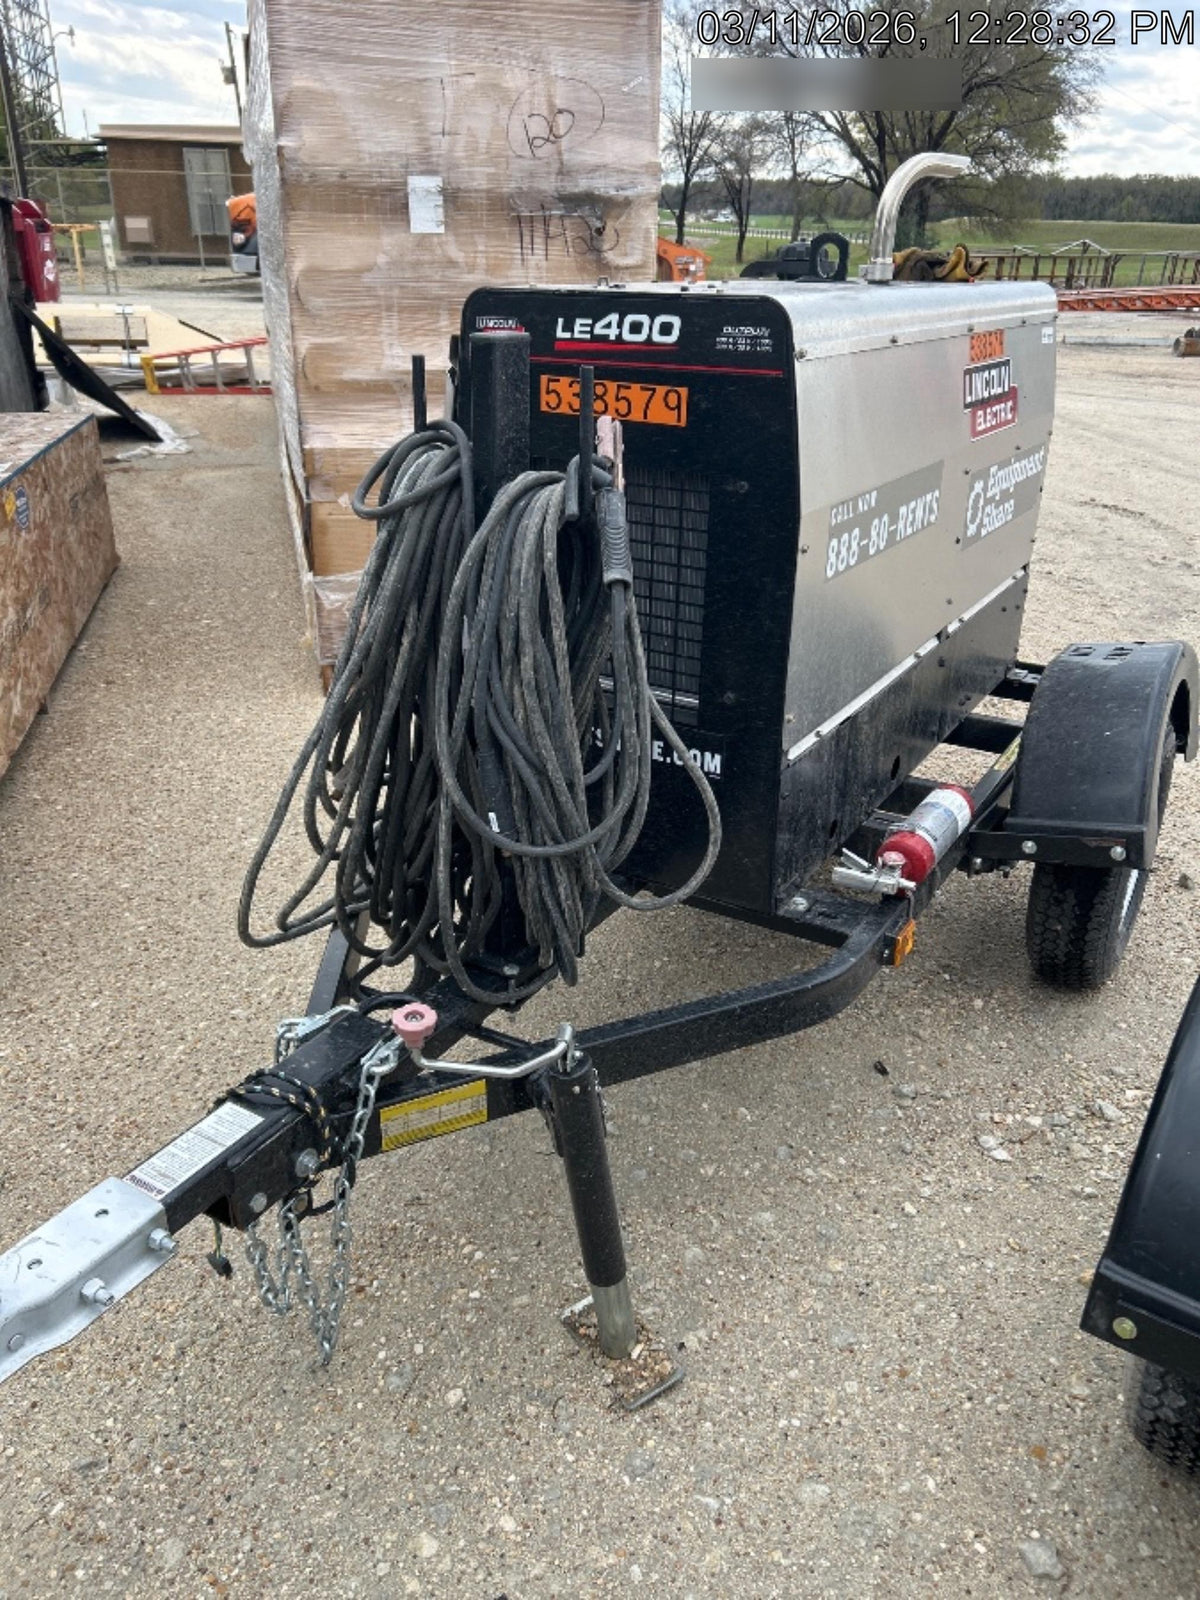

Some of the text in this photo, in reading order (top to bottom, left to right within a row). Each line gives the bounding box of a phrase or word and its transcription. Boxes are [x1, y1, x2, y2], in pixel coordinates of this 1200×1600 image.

[556, 312, 681, 344] LE400
[545, 377, 682, 424] 538579
[965, 366, 1009, 404] LINCOLN
[976, 400, 1014, 431] ELECTRIC
[986, 446, 1045, 500] Equipment
[831, 490, 878, 526] CALL NOW
[981, 498, 1014, 538] Share
[826, 489, 940, 579] 888-80-RENTS
